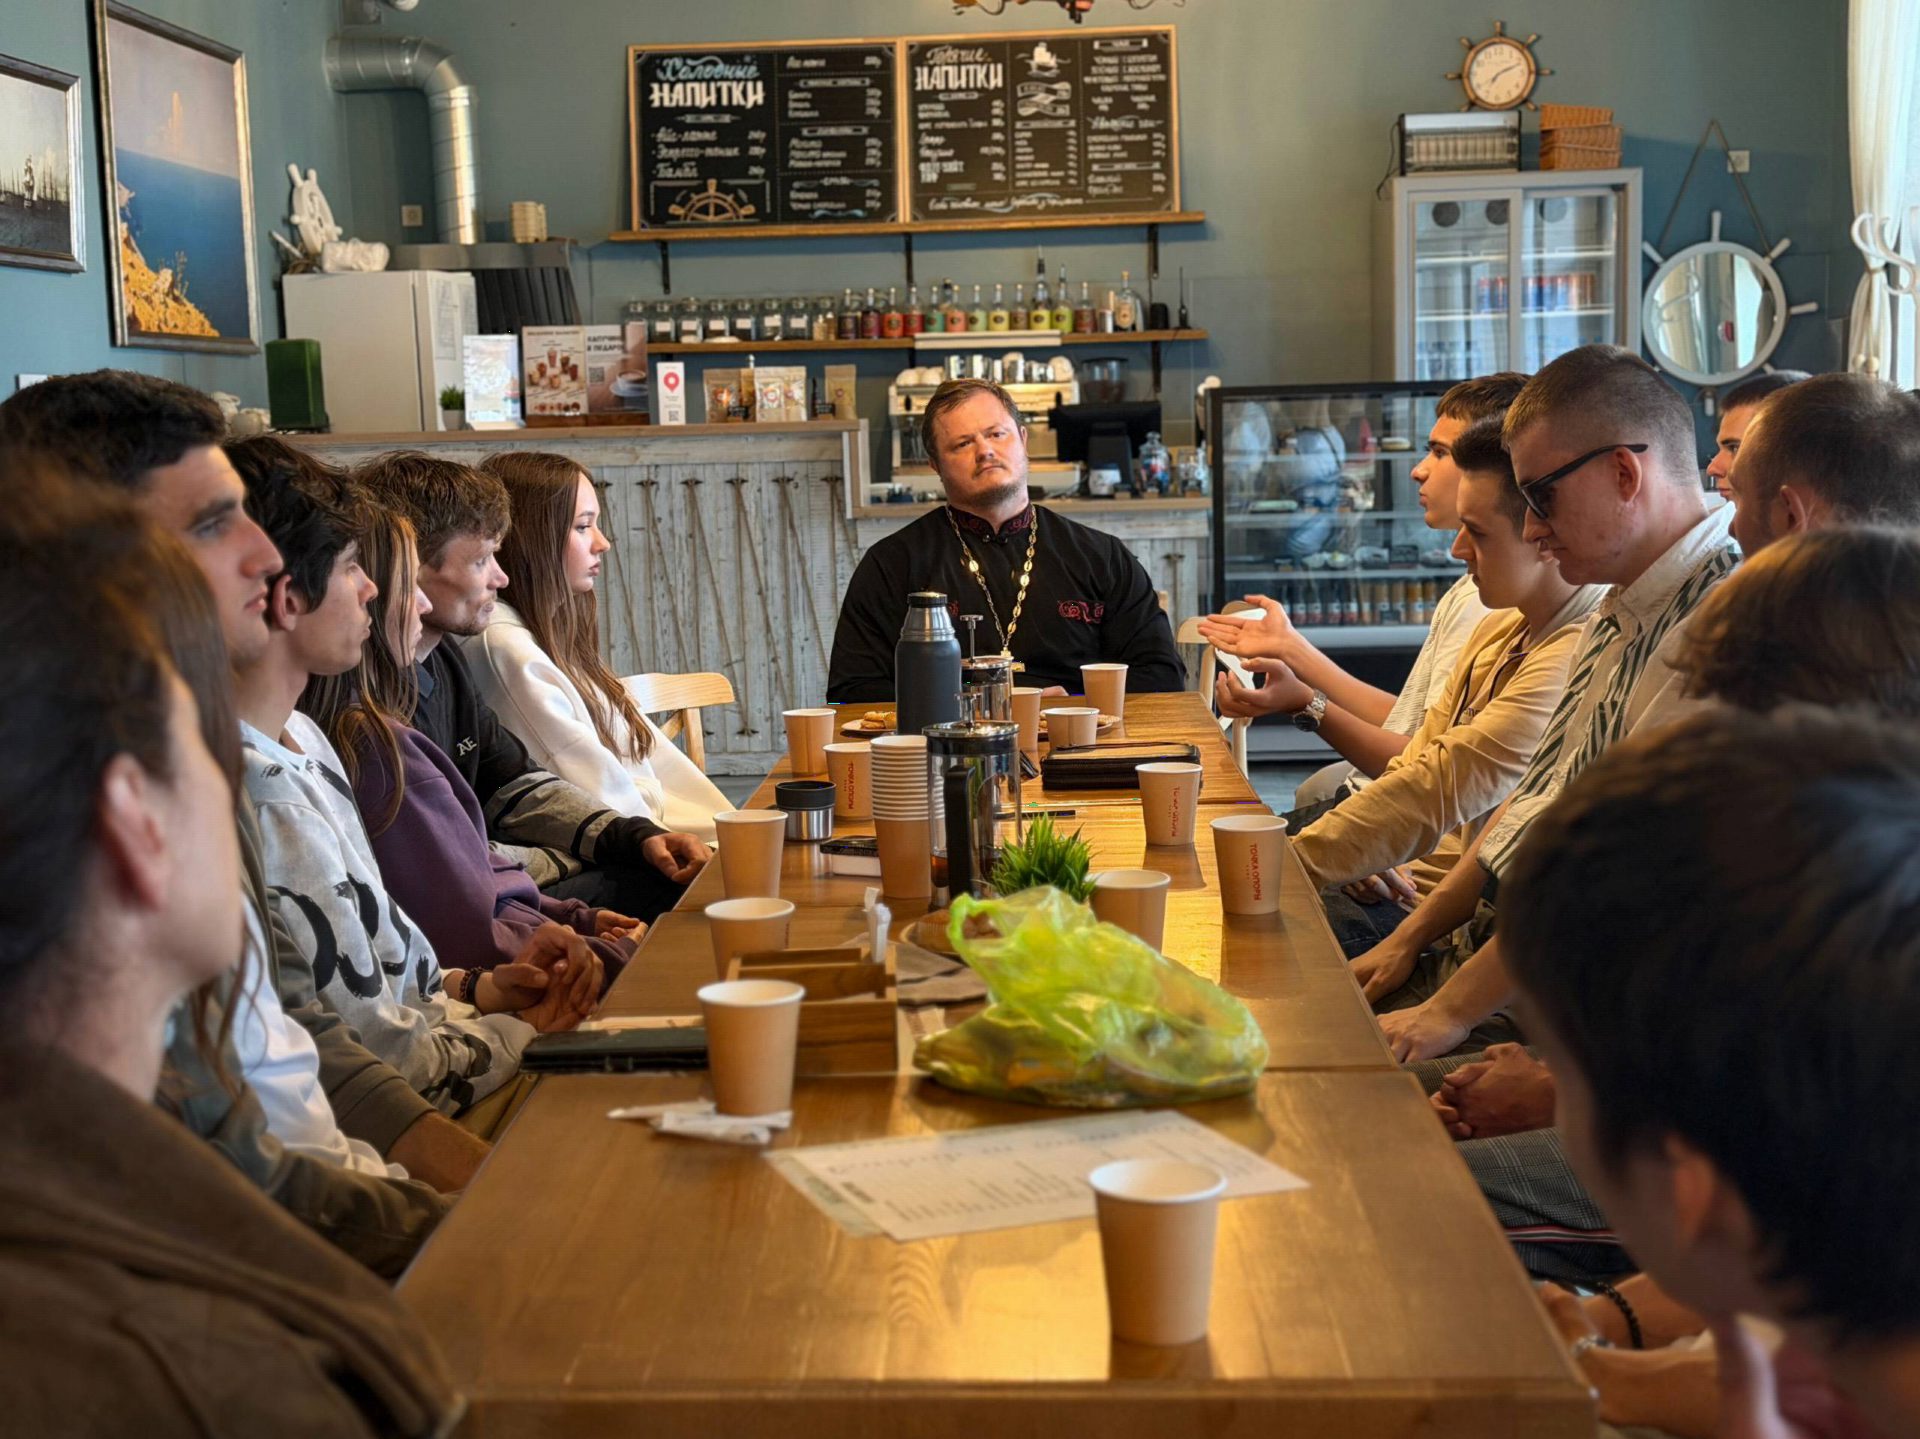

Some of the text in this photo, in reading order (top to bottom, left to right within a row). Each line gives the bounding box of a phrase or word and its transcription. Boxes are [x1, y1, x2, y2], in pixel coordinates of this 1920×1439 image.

[656, 56, 760, 82] Холодные
[914, 63, 1004, 90] НАПИТКИ
[648, 80, 766, 109] НАПИТКИ
[1250, 843, 1262, 900] ТОЧКА ОПОРЫ
